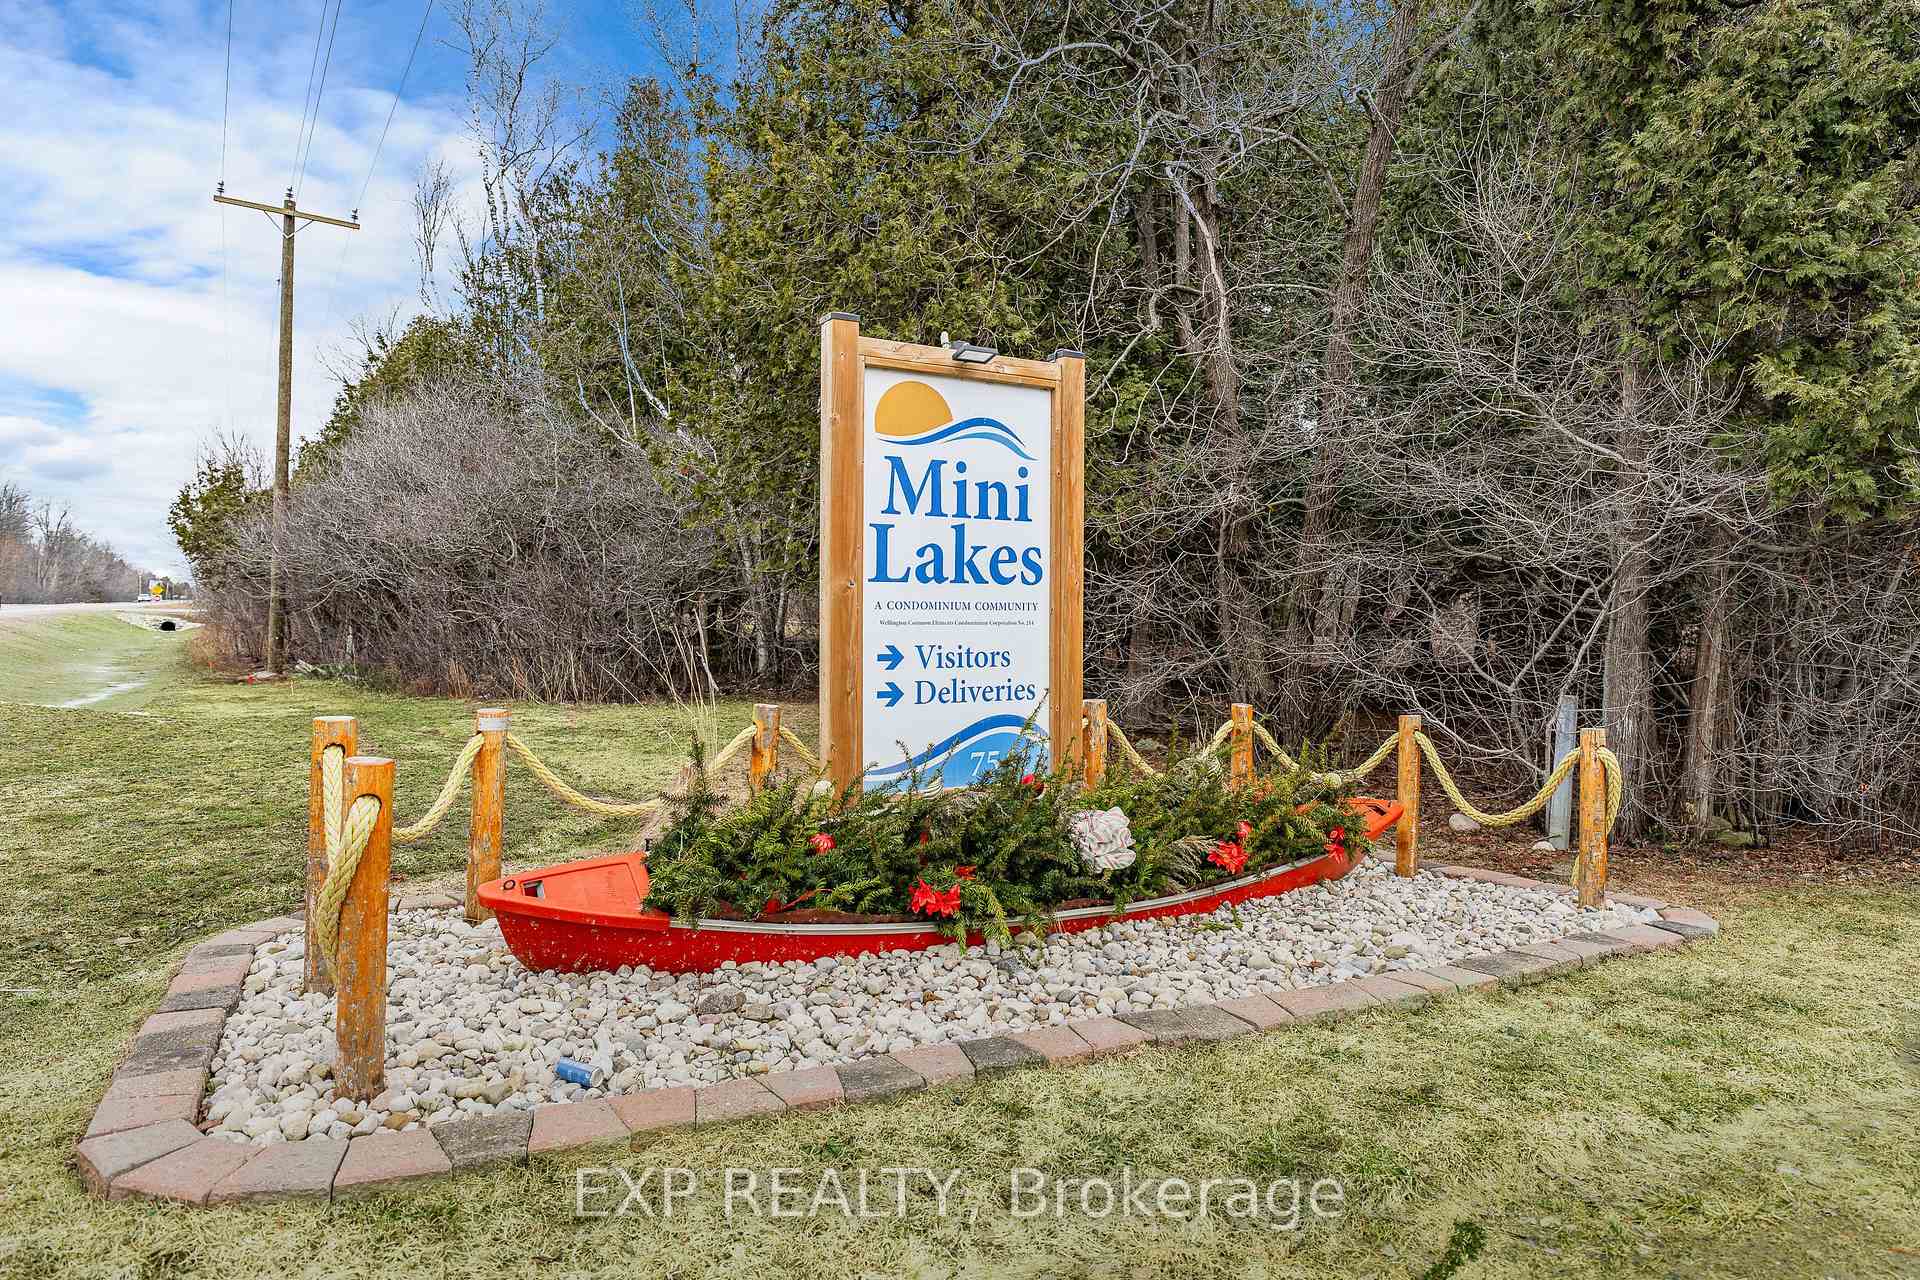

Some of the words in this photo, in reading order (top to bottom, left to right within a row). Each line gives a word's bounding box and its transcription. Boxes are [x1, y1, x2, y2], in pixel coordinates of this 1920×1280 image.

[881, 455, 1032, 522] Mini
[868, 523, 1043, 585] Lakes
[874, 600, 883, 611] A
[886, 600, 971, 611] CONDOMINIUM
[974, 601, 1039, 611] COMMUNITY
[914, 644, 1011, 669] Visitors
[914, 678, 1036, 705] Deliveries
